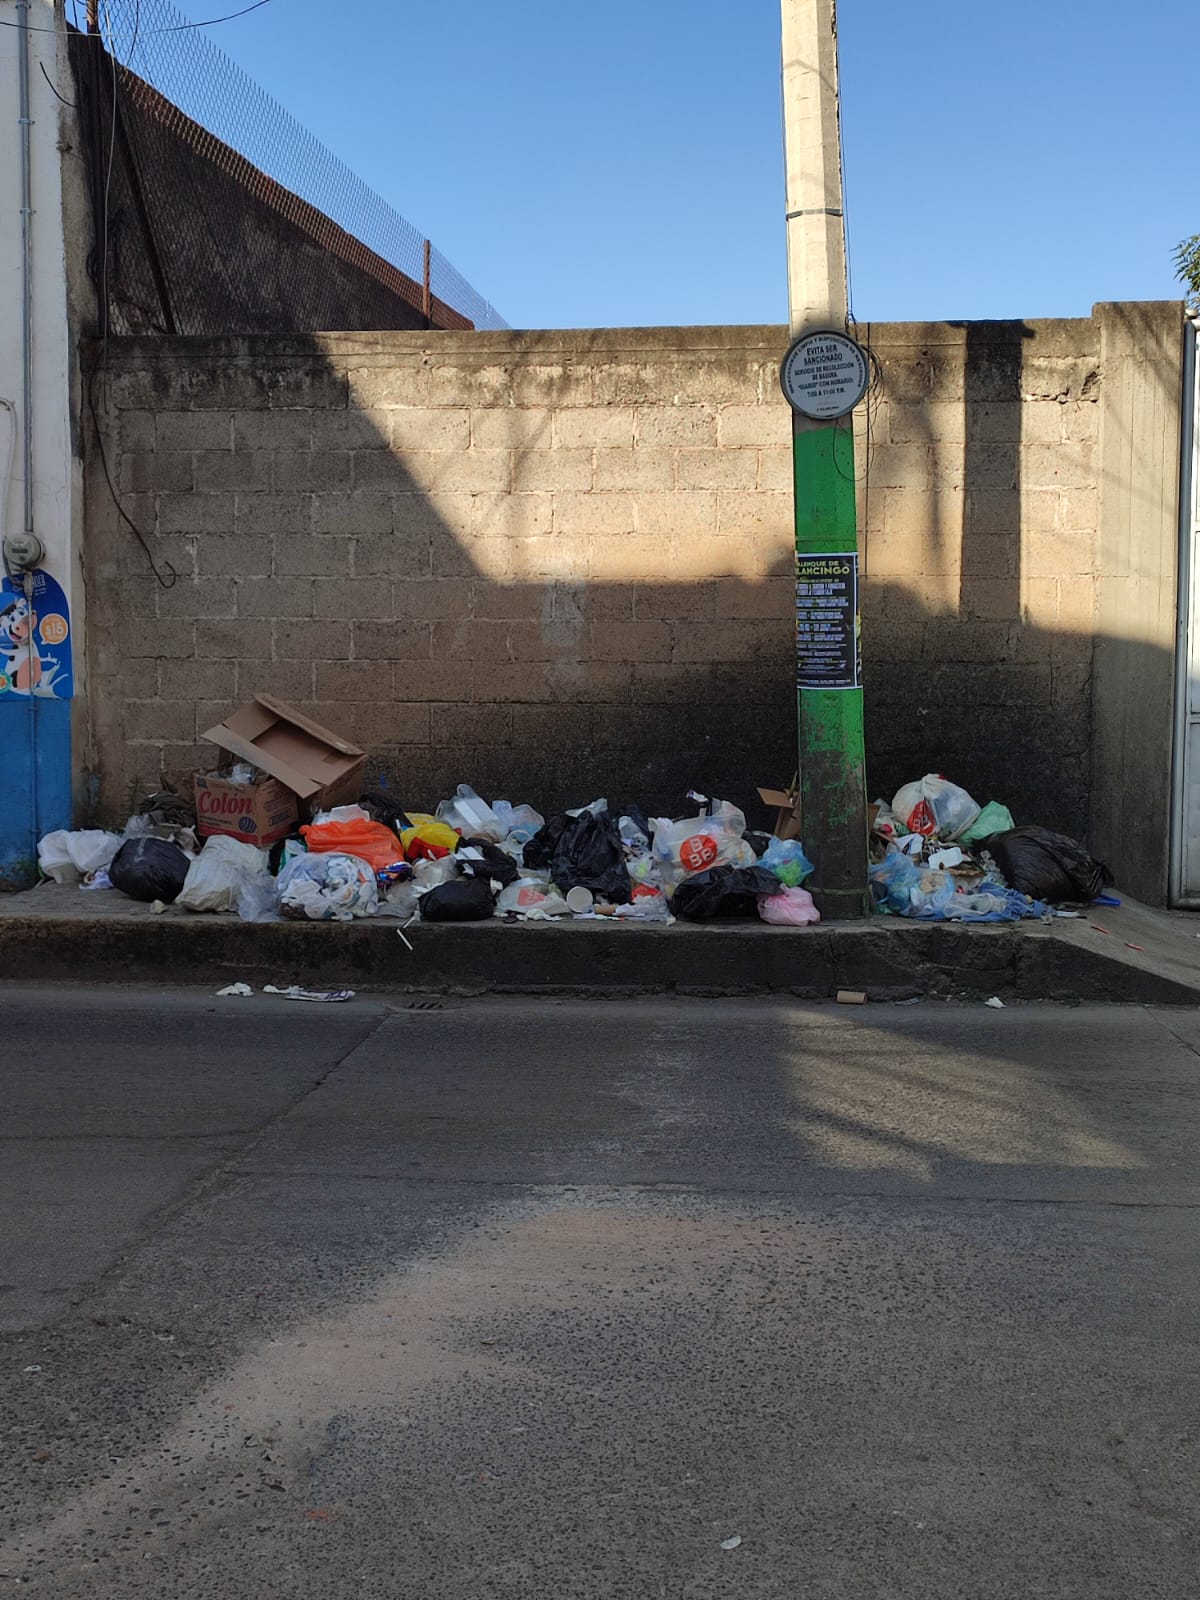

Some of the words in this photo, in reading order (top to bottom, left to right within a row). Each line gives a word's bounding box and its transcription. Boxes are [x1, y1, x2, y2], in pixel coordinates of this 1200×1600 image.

[807, 346, 824, 355] EVITA
[826, 345, 837, 353] SER
[804, 353, 842, 366] SANCIONADO
[794, 367, 815, 376] SERVICIO
[199, 791, 252, 814] Colón
